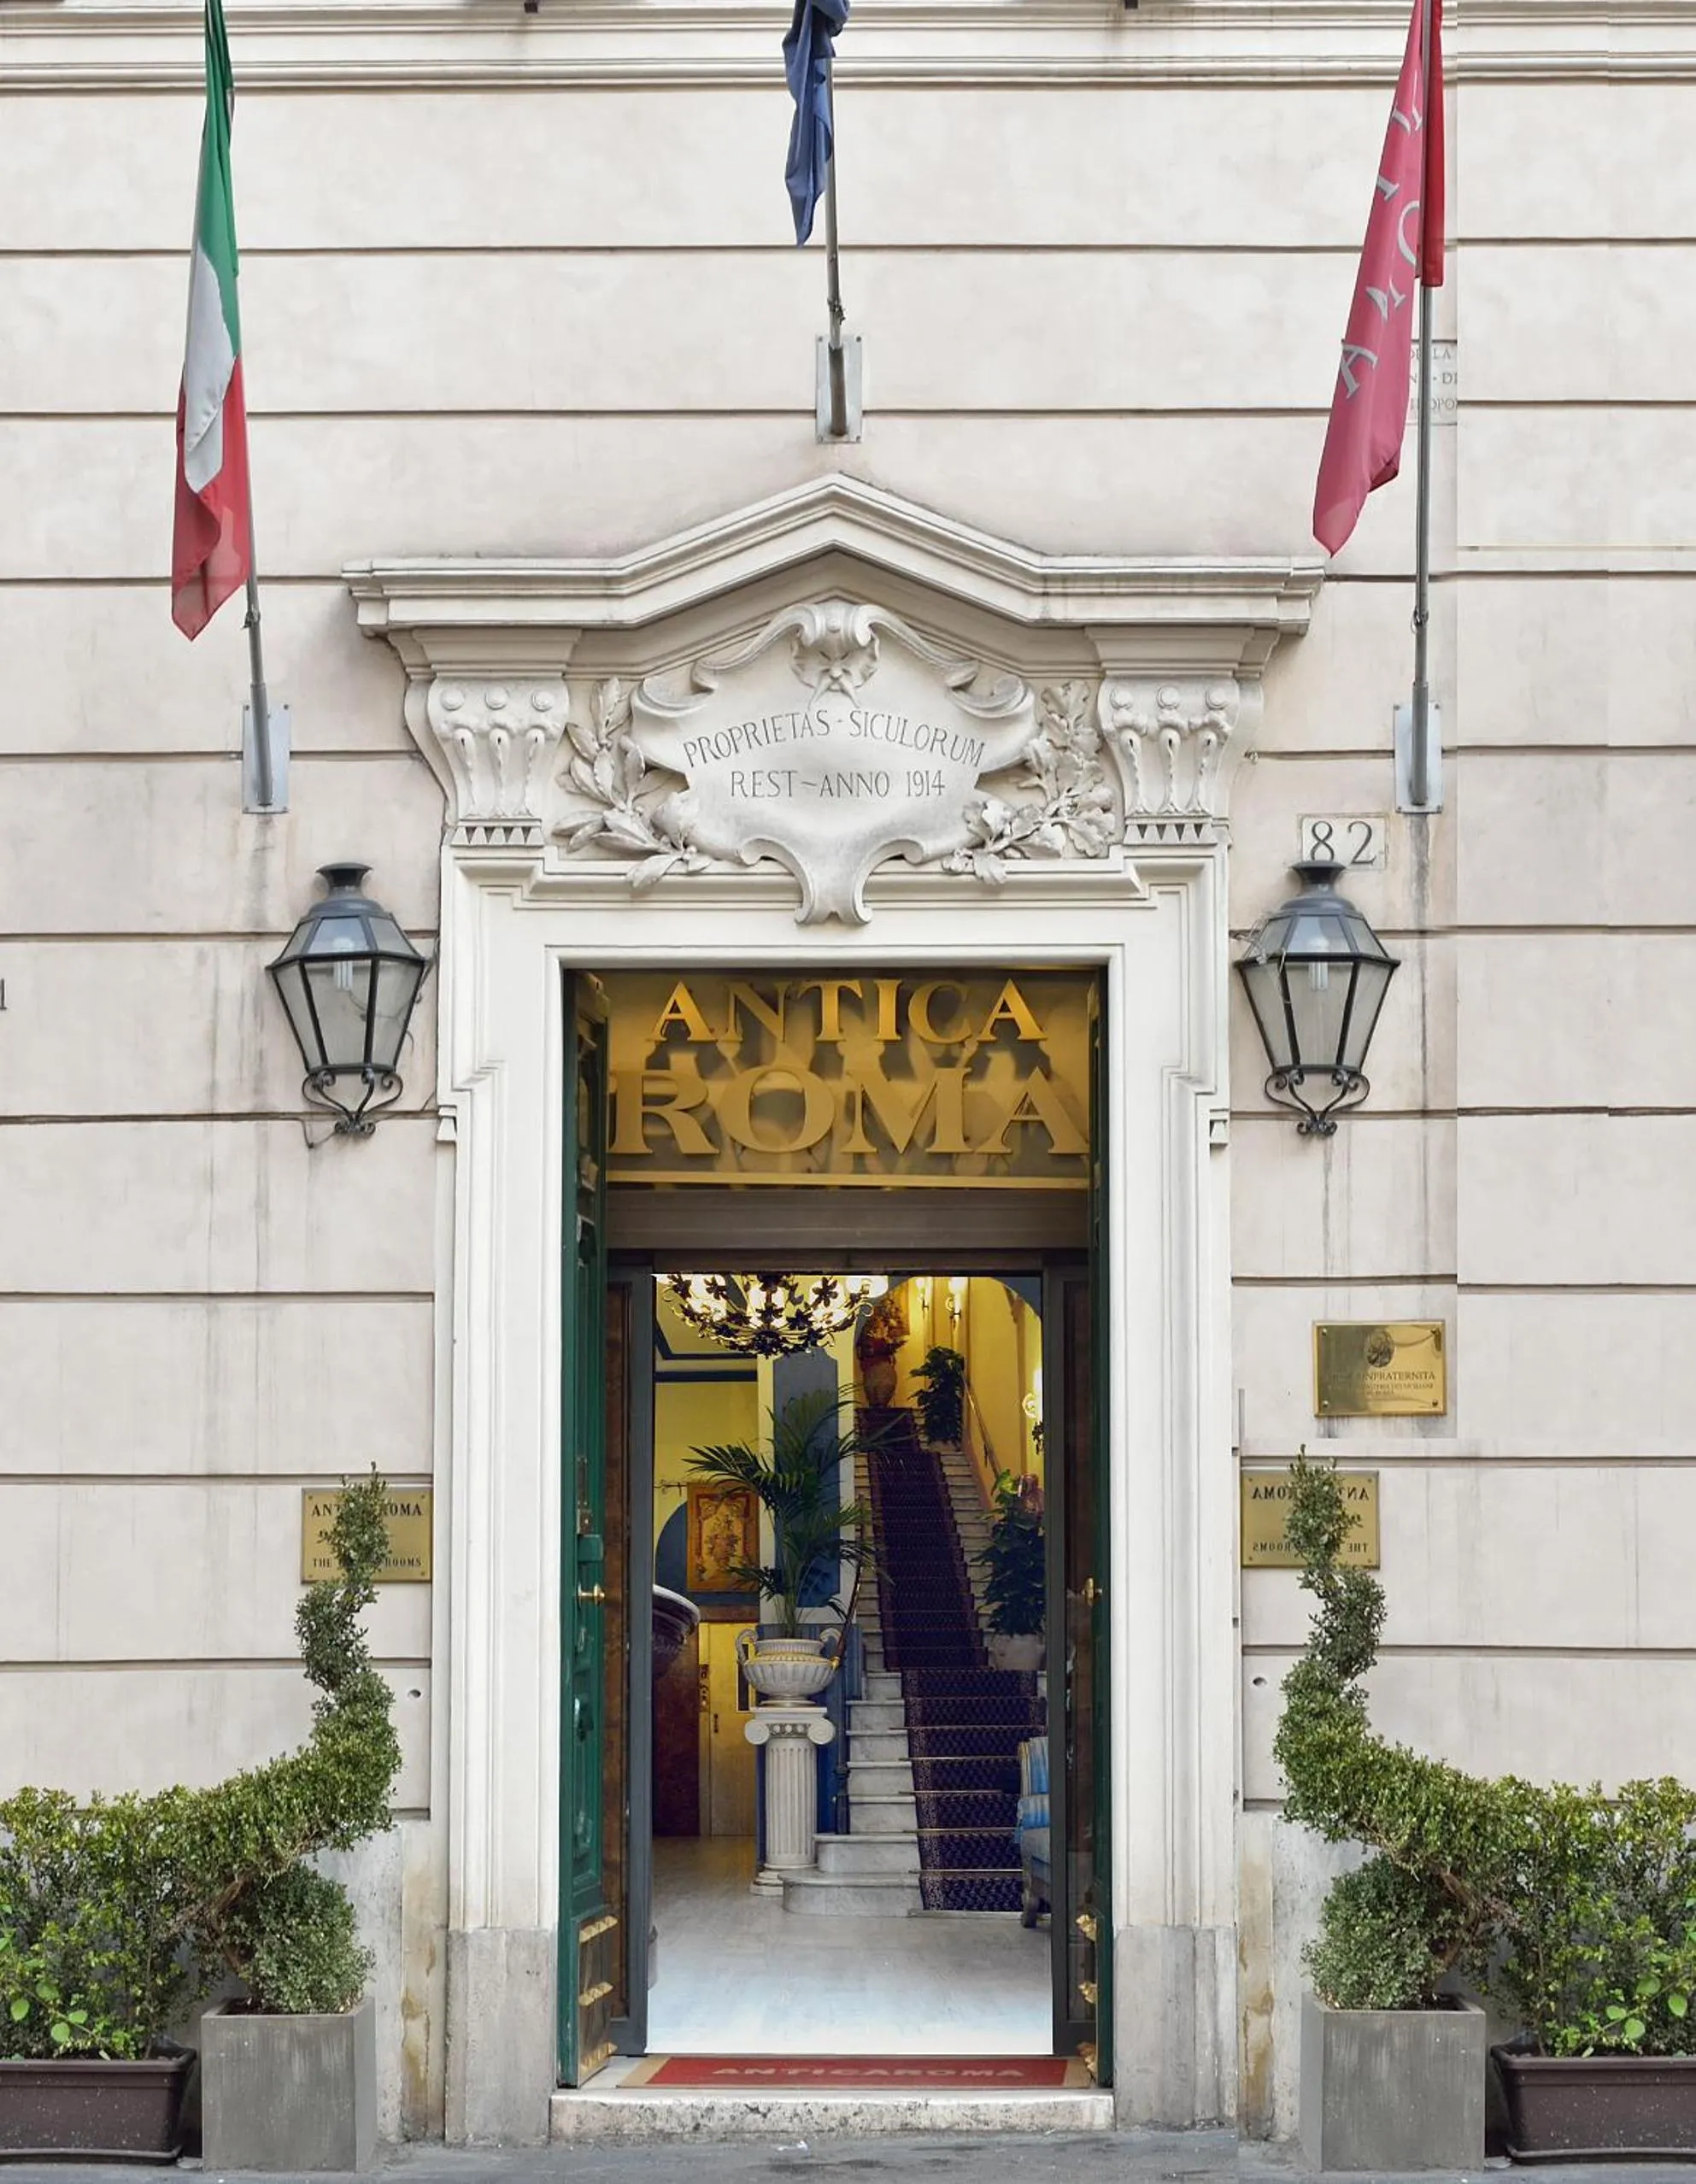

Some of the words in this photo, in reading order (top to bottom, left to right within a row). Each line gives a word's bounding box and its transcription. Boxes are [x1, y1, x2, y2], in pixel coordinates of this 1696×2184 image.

[683, 709, 832, 768] PROPRIETAS
[848, 709, 986, 768] SICULORUM
[731, 770, 800, 799] REST
[819, 772, 890, 798] ANNO
[907, 770, 946, 797] 1914
[1310, 820, 1376, 865] 82
[650, 978, 1048, 1044] ANTICA
[608, 1066, 1091, 1155] ROMA
